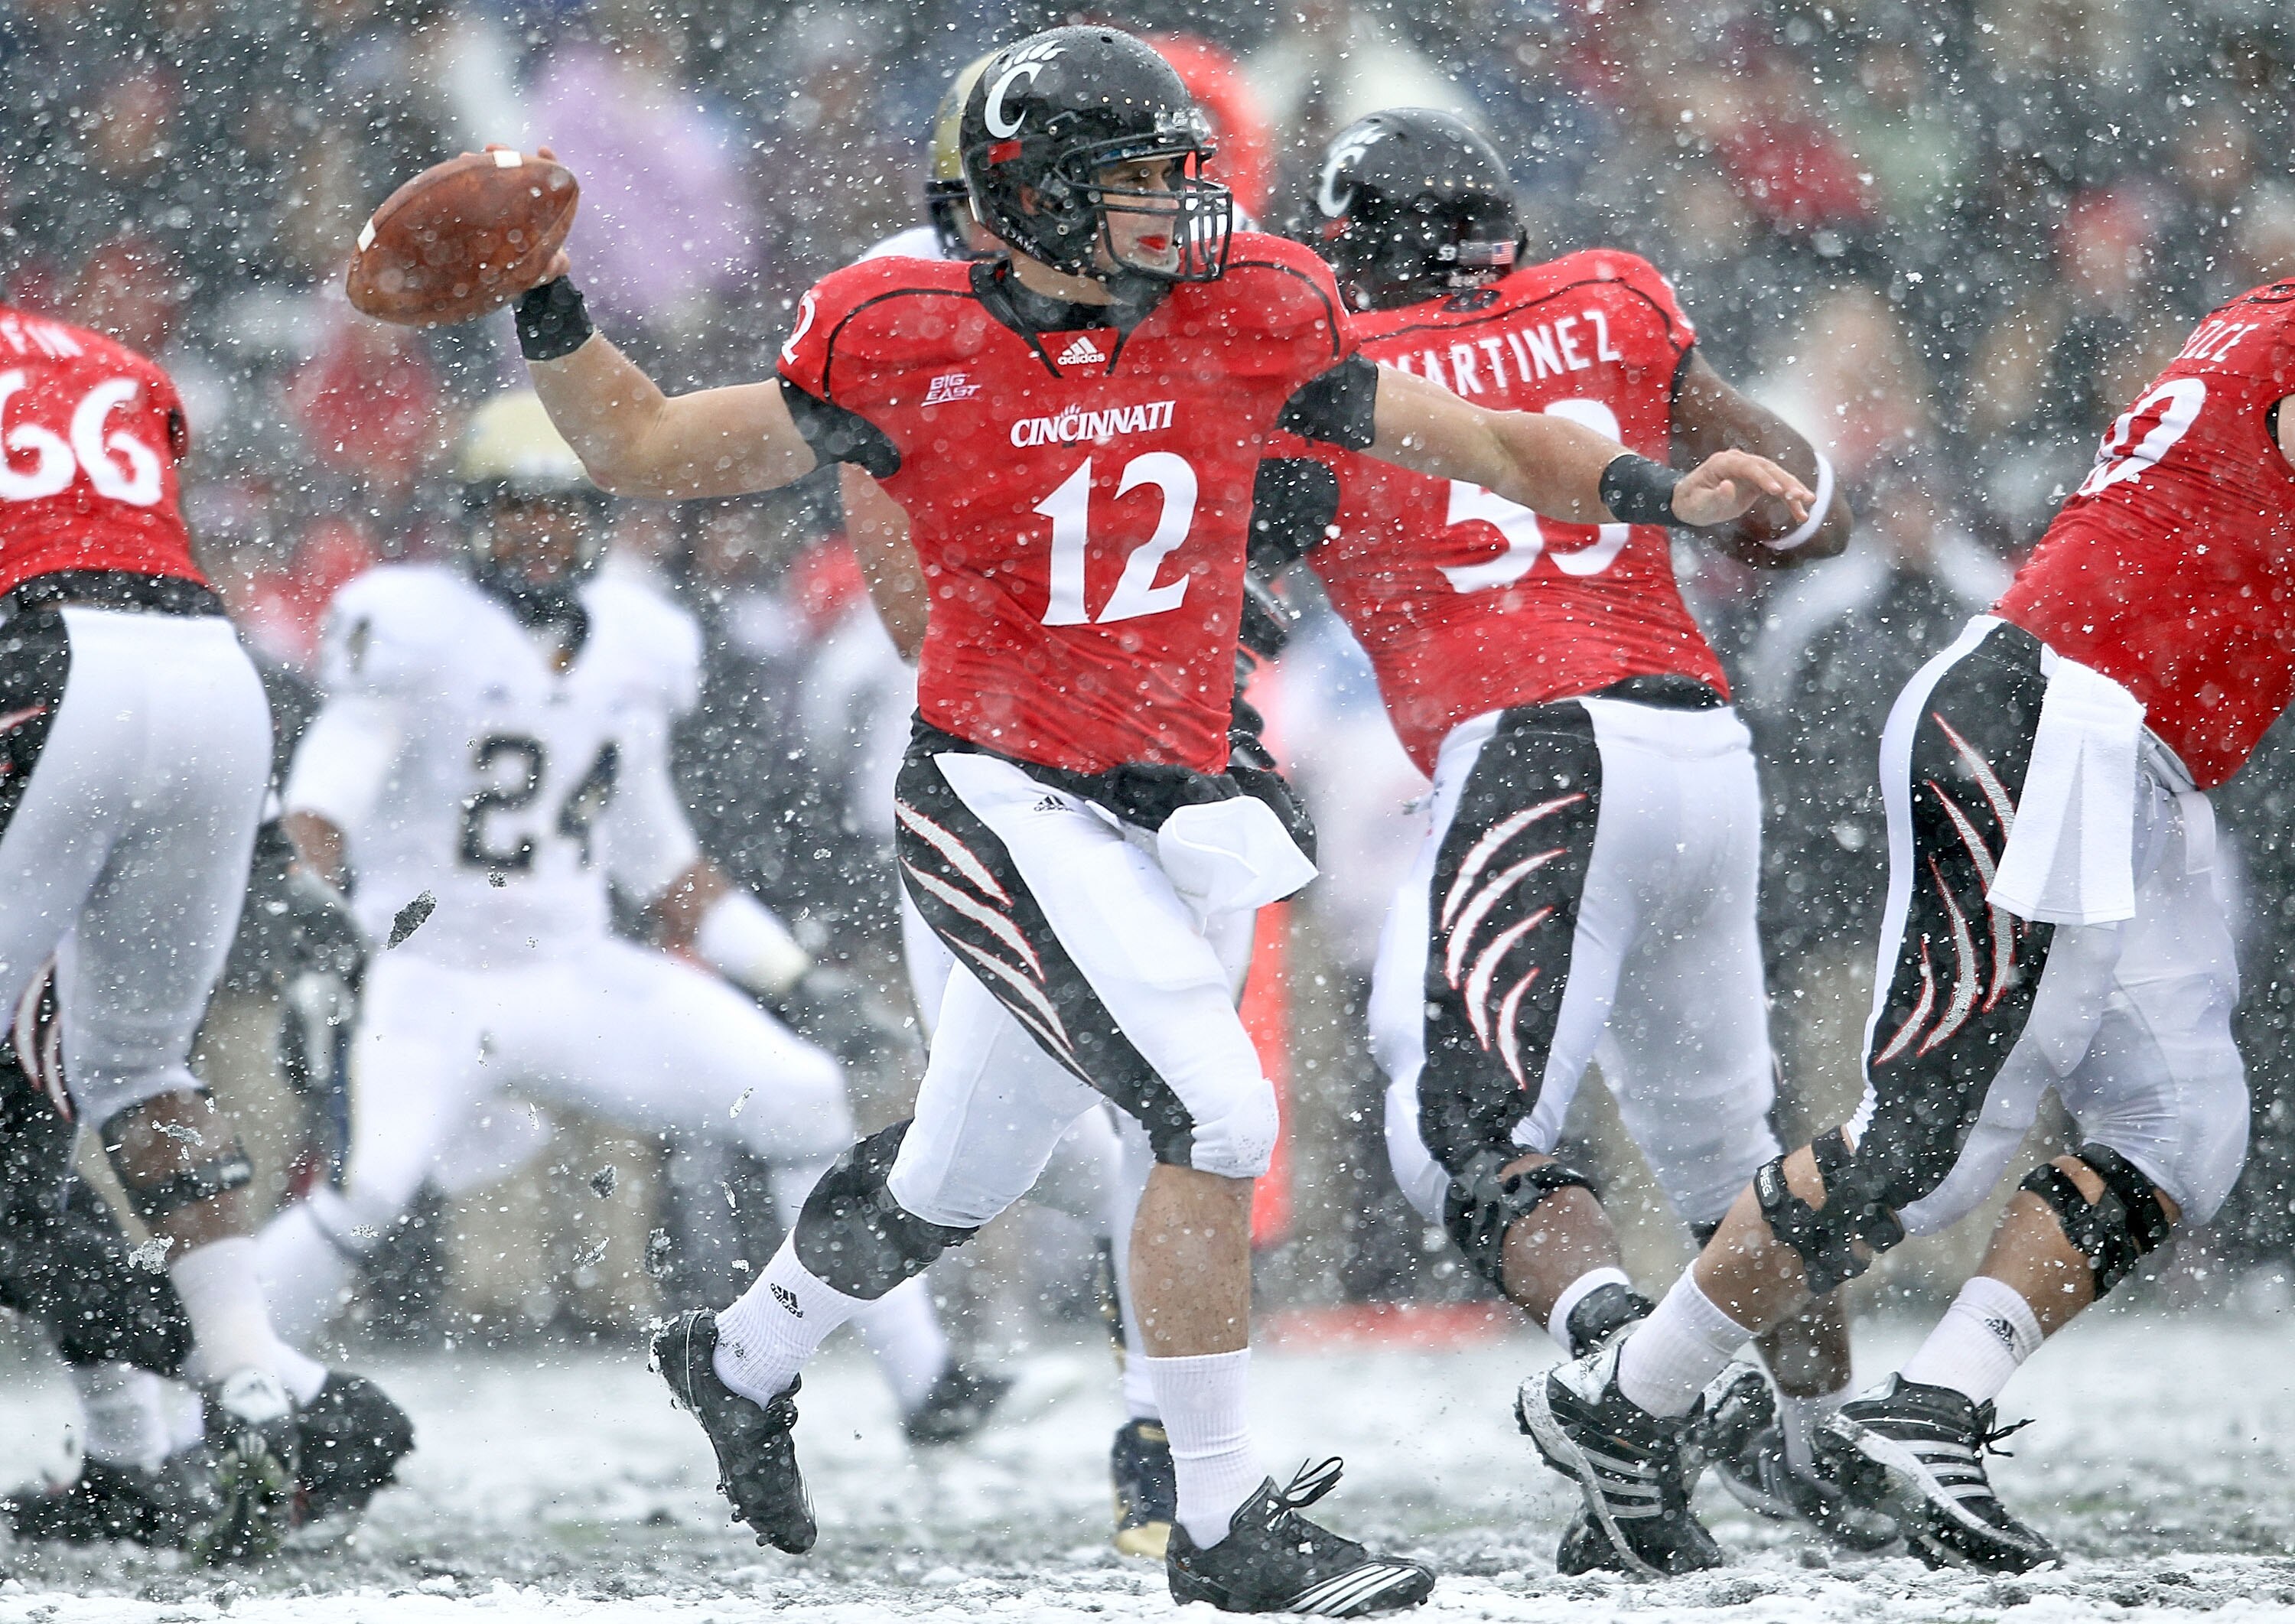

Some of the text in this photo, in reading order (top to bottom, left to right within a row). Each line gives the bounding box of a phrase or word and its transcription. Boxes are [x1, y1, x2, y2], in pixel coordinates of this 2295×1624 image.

[985, 62, 1043, 138] C
[1318, 146, 1366, 217] C
[1437, 244, 1457, 261] 53
[930, 373, 968, 390] BIG
[1057, 353, 1106, 366] adidas
[926, 385, 981, 401] EAST
[0, 367, 163, 506] 66
[1010, 401, 1176, 448] CINCINNATI
[2078, 379, 2206, 496] 0
[1034, 451, 1198, 626] 12
[461, 736, 621, 871] 24
[770, 1283, 804, 1318] adidas
